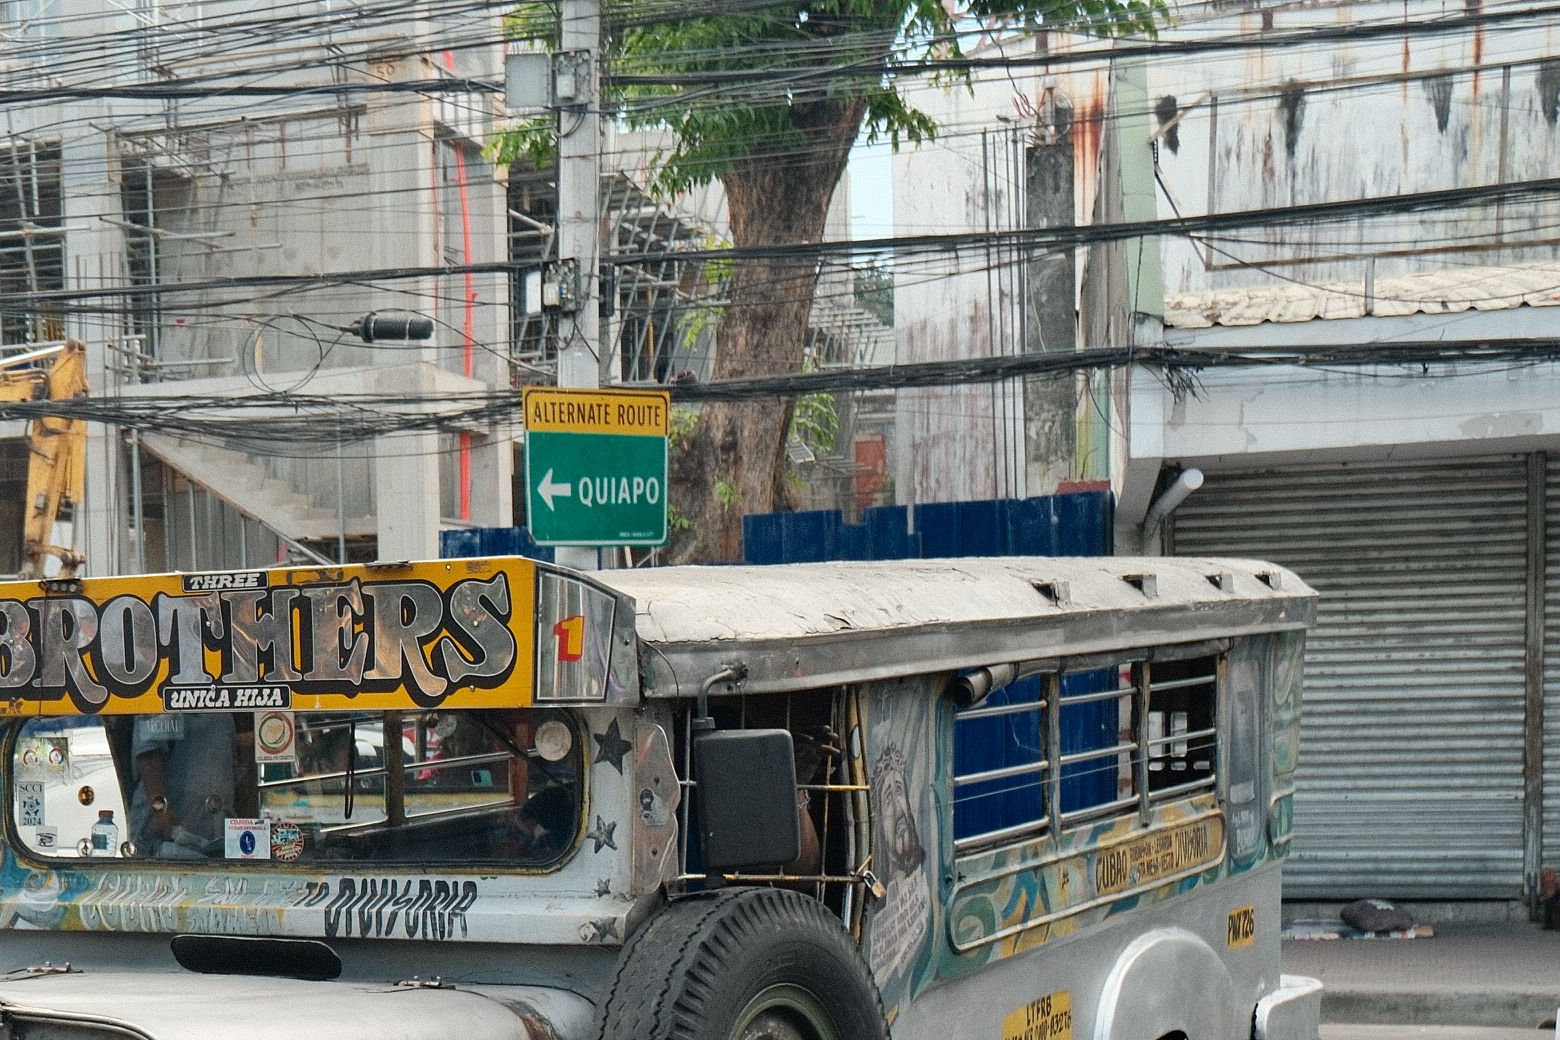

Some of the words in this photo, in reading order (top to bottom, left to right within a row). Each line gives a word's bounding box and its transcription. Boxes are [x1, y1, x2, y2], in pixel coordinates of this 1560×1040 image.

[533, 402, 611, 425] ALTERNATE
[618, 404, 661, 427] ROUTE
[578, 476, 660, 508] QUIAPO
[189, 573, 260, 591] THREE
[553, 615, 585, 663] 1
[171, 688, 229, 709] UNICA
[233, 688, 287, 709] HIJA
[20, 783, 43, 793] SCCI
[23, 817, 42, 826] 2024
[1096, 850, 1128, 895] CUBAO
[294, 880, 331, 908] TO
[324, 877, 479, 939] DIVISORIA
[1026, 995, 1052, 1027] LTFRB
